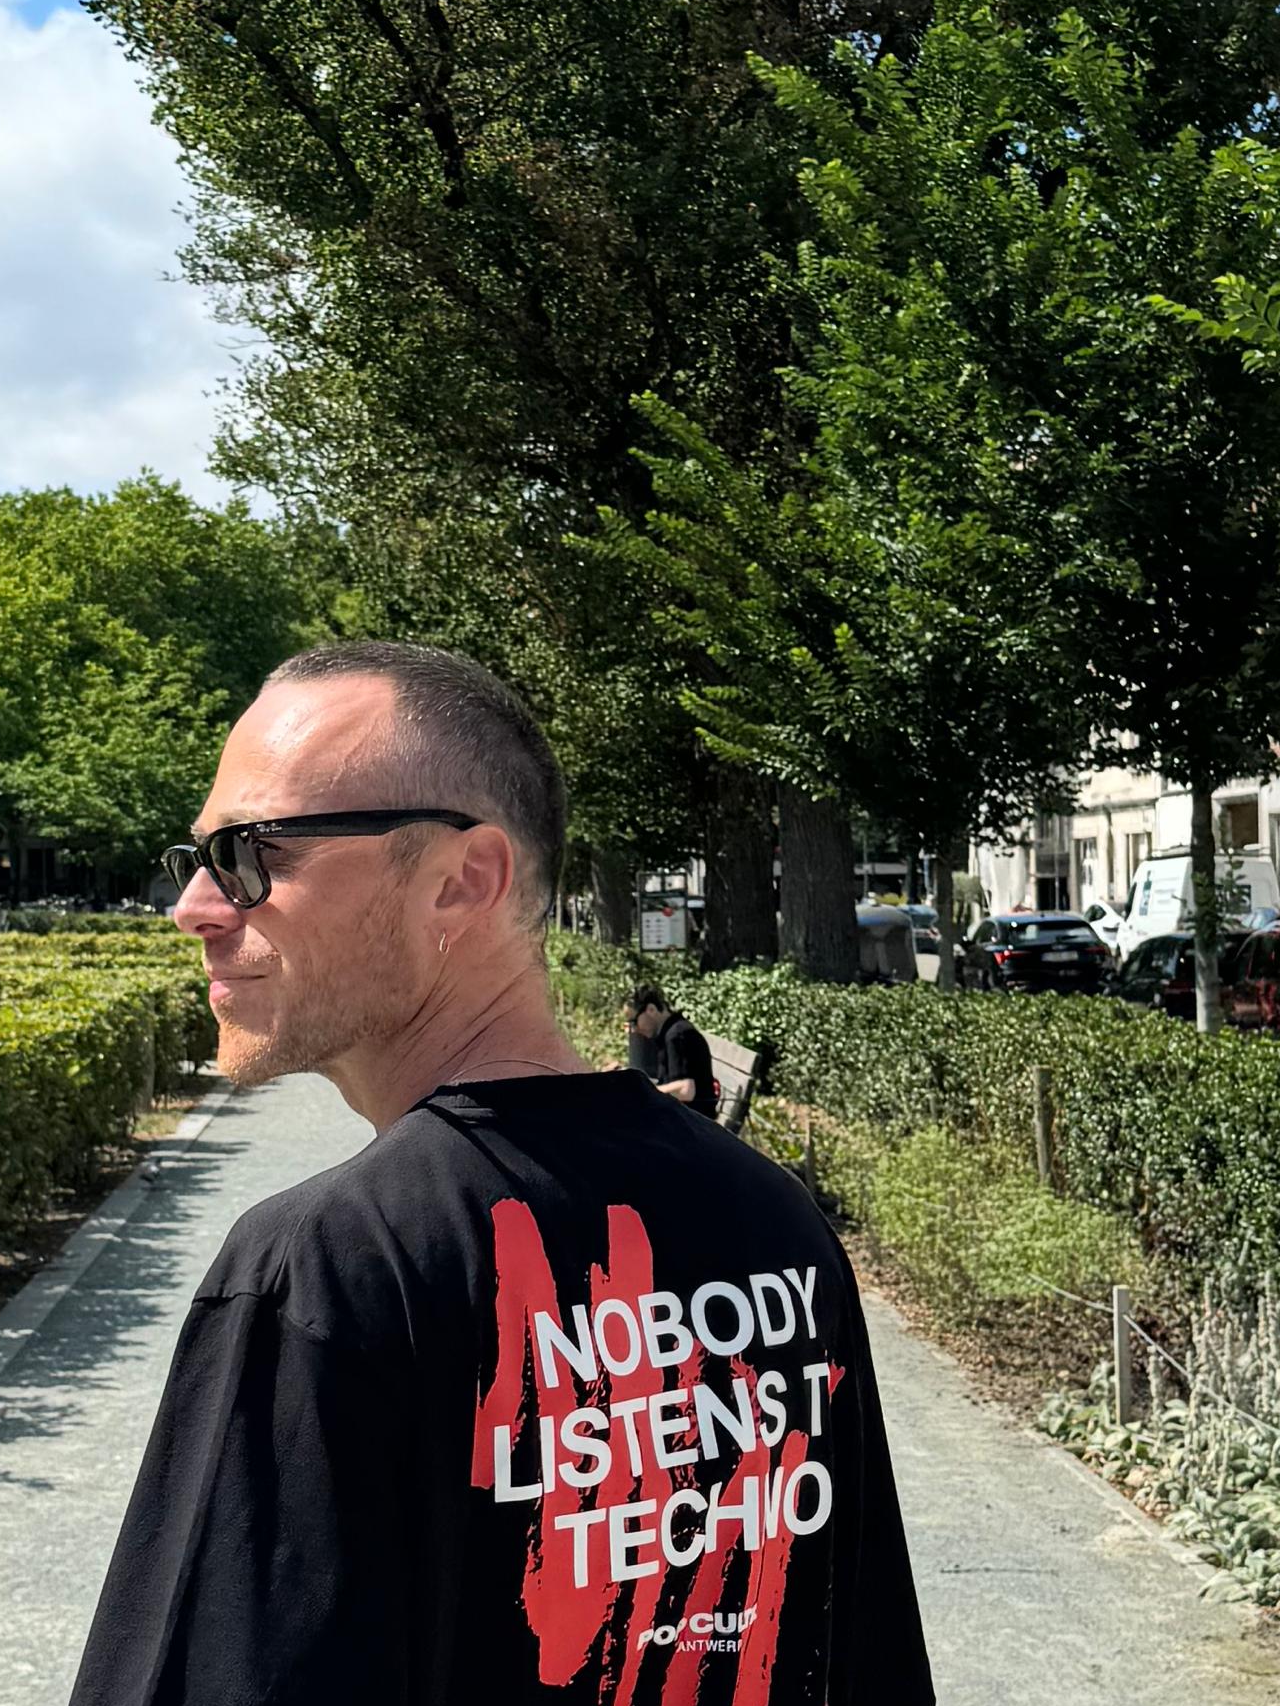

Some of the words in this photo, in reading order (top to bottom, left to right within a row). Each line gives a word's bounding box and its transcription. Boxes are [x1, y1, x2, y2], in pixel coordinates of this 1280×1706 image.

[534, 1266, 817, 1389] NOBODY
[493, 1370, 787, 1503] LISTENS
[802, 1362, 830, 1438] T
